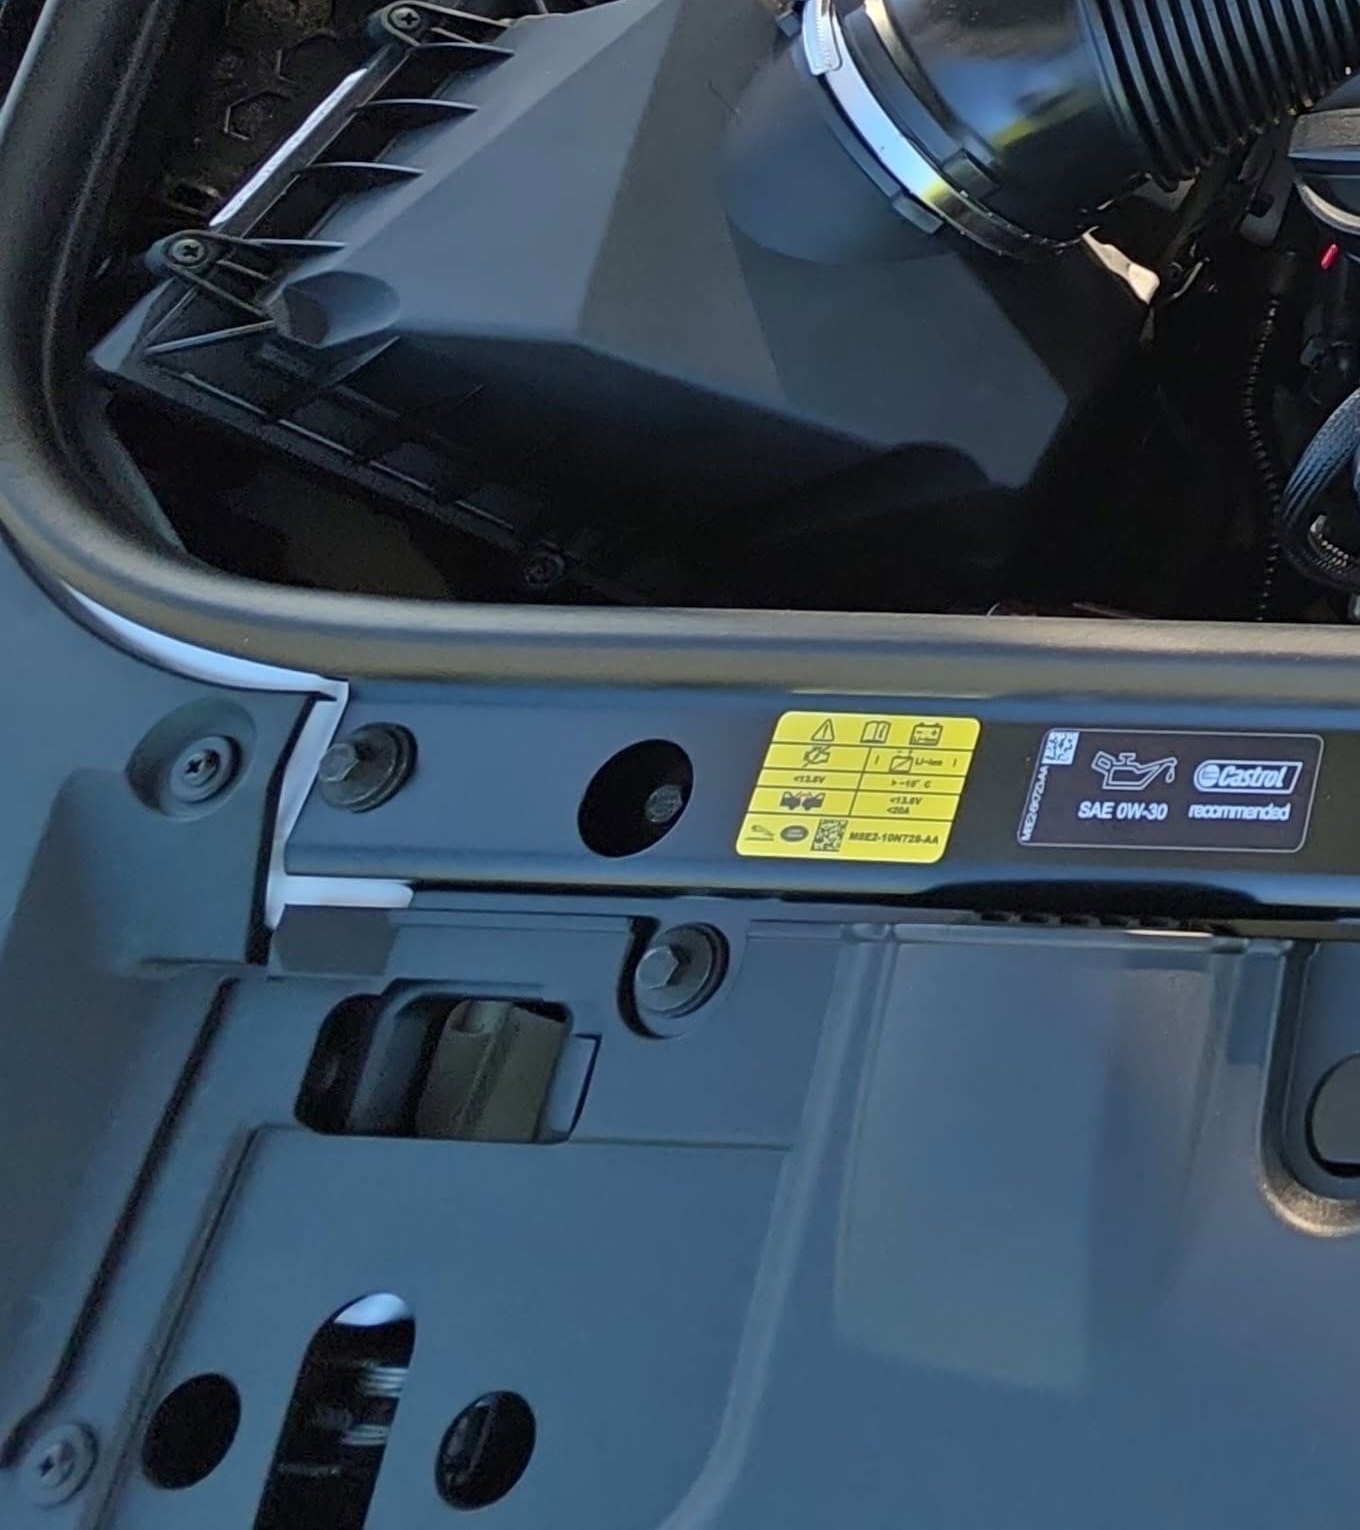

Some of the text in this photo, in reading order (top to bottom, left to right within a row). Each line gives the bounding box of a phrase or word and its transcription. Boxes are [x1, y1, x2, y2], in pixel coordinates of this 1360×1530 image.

[1218, 764, 1287, 788] Castrol
[1078, 801, 1168, 820] SAE 0W-30
[1188, 803, 1291, 820] recommended
